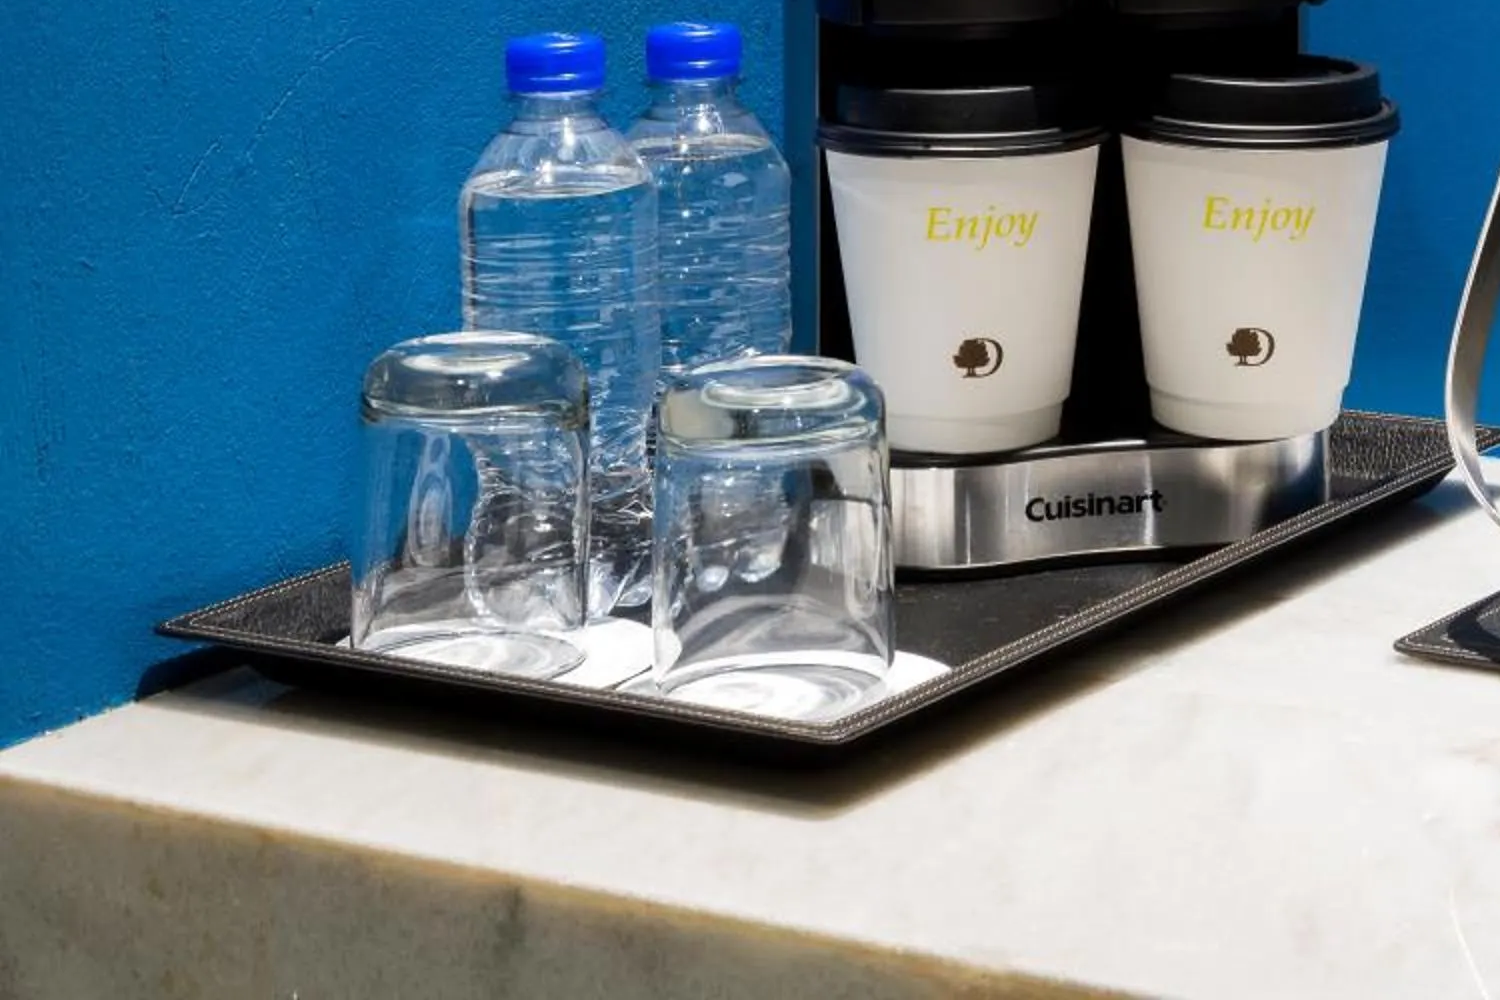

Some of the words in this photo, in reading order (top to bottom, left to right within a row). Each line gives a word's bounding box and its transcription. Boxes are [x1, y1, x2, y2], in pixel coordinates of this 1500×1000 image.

[926, 205, 1038, 251] Enjoy
[1202, 195, 1316, 243] Enjoy
[1024, 489, 1165, 522] Cuisinart
